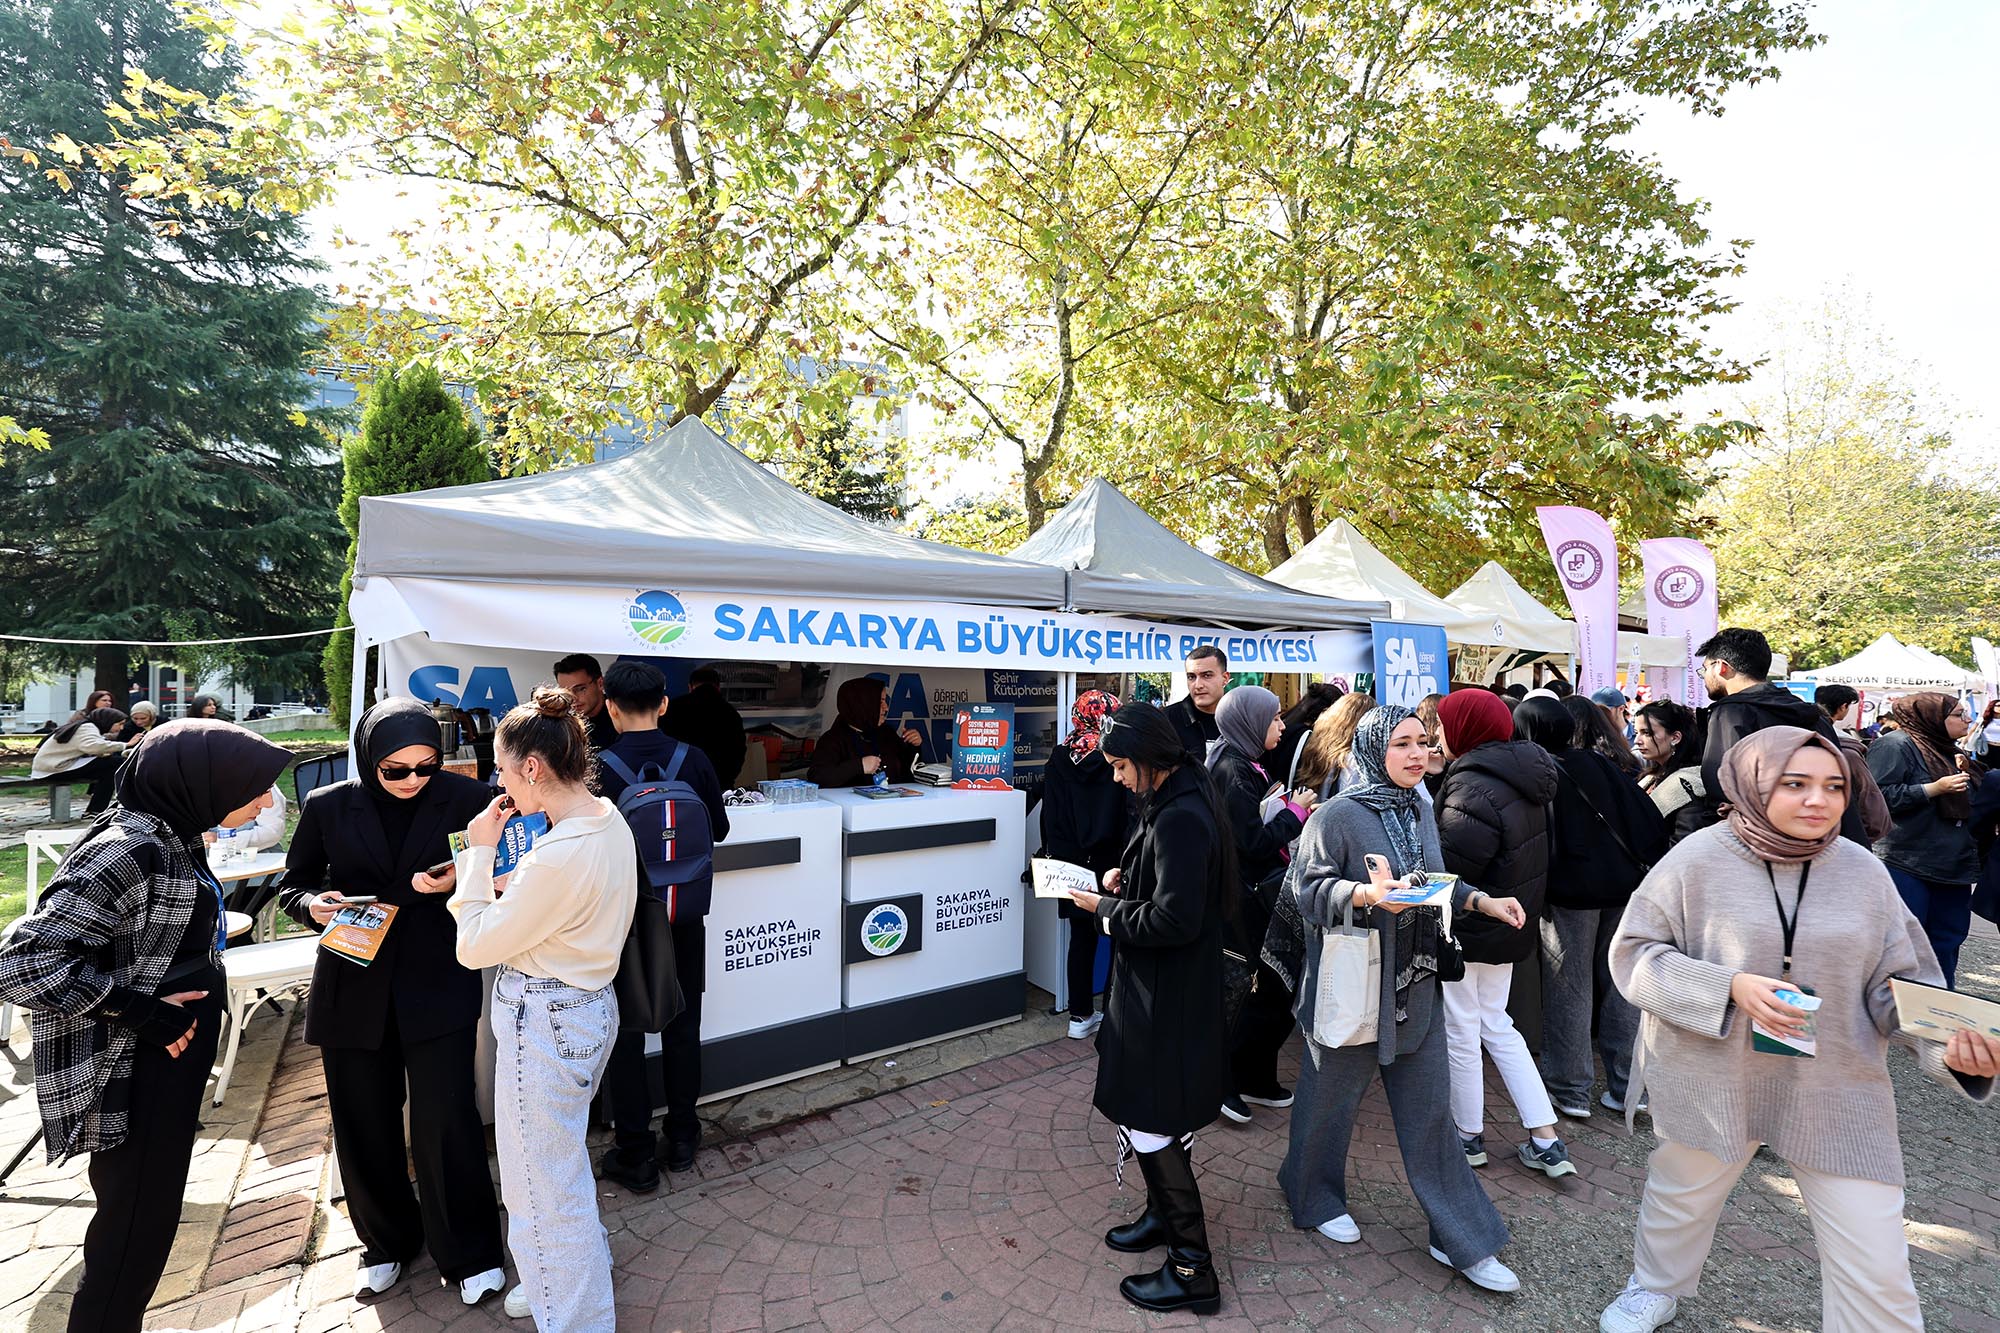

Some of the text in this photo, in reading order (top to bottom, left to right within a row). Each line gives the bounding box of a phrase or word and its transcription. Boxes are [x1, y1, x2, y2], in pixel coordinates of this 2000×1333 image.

[713, 603, 946, 653] SAKARYA
[957, 615, 1174, 665] BÜYÜKŞEHİR
[1494, 624, 1503, 637] 13
[1385, 637, 1420, 676] SA
[992, 672, 1019, 684] Şehir
[408, 665, 519, 721] SA
[933, 688, 969, 703] ÖĞRENCİ
[993, 684, 1058, 698] Kütüphanes
[968, 734, 999, 746] TAKİP ET!
[966, 752, 1001, 763] HEDİYENİ
[966, 764, 1000, 775] KAZAN!
[936, 888, 992, 906] SAKARYA
[936, 896, 1010, 919] BÜYÜKŞEHİR
[724, 919, 797, 941] SAKARYA
[936, 910, 1003, 932] BELEDİYESİ
[725, 928, 821, 957] BÜYÜKŞEHİR
[725, 942, 812, 972] BELEDİYESİ
